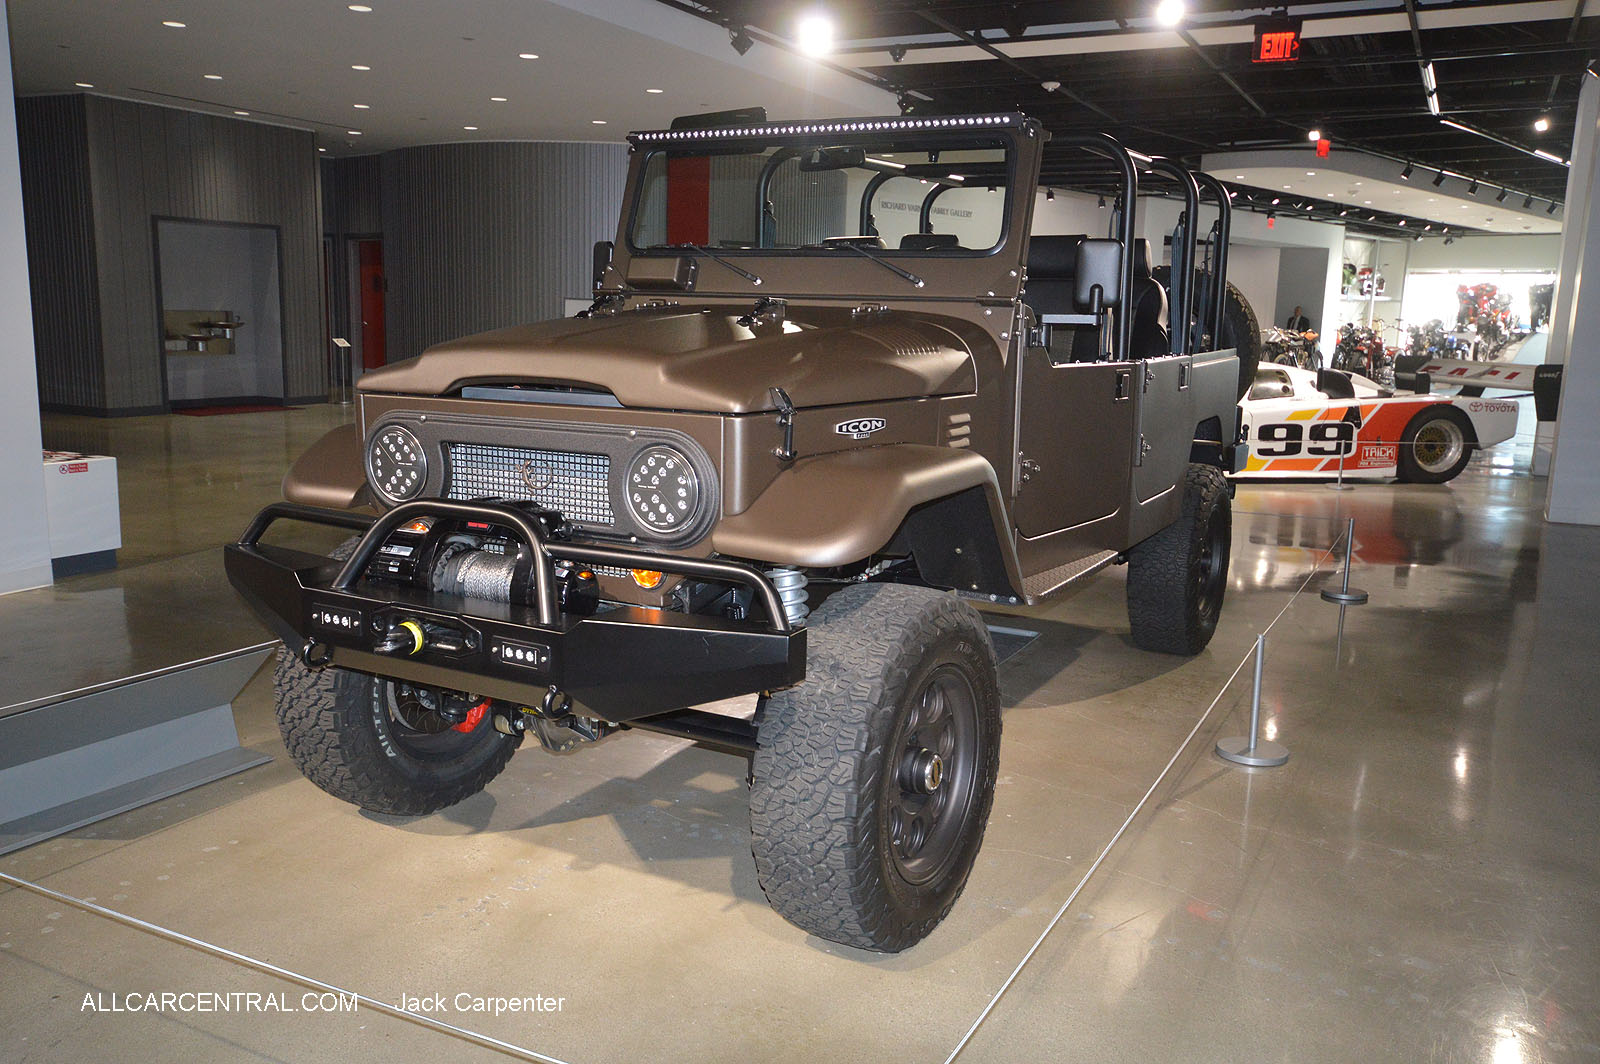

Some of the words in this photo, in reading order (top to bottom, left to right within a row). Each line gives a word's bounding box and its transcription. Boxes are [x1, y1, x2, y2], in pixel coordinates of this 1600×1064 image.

[1260, 32, 1296, 59] EXIT
[881, 201, 907, 211] RICHARD
[949, 208, 973, 218] GALLERY
[1485, 405, 1516, 413] TOYOTA
[842, 420, 882, 432] ICON
[1257, 423, 1354, 456] 99
[1364, 447, 1394, 457] TRICK
